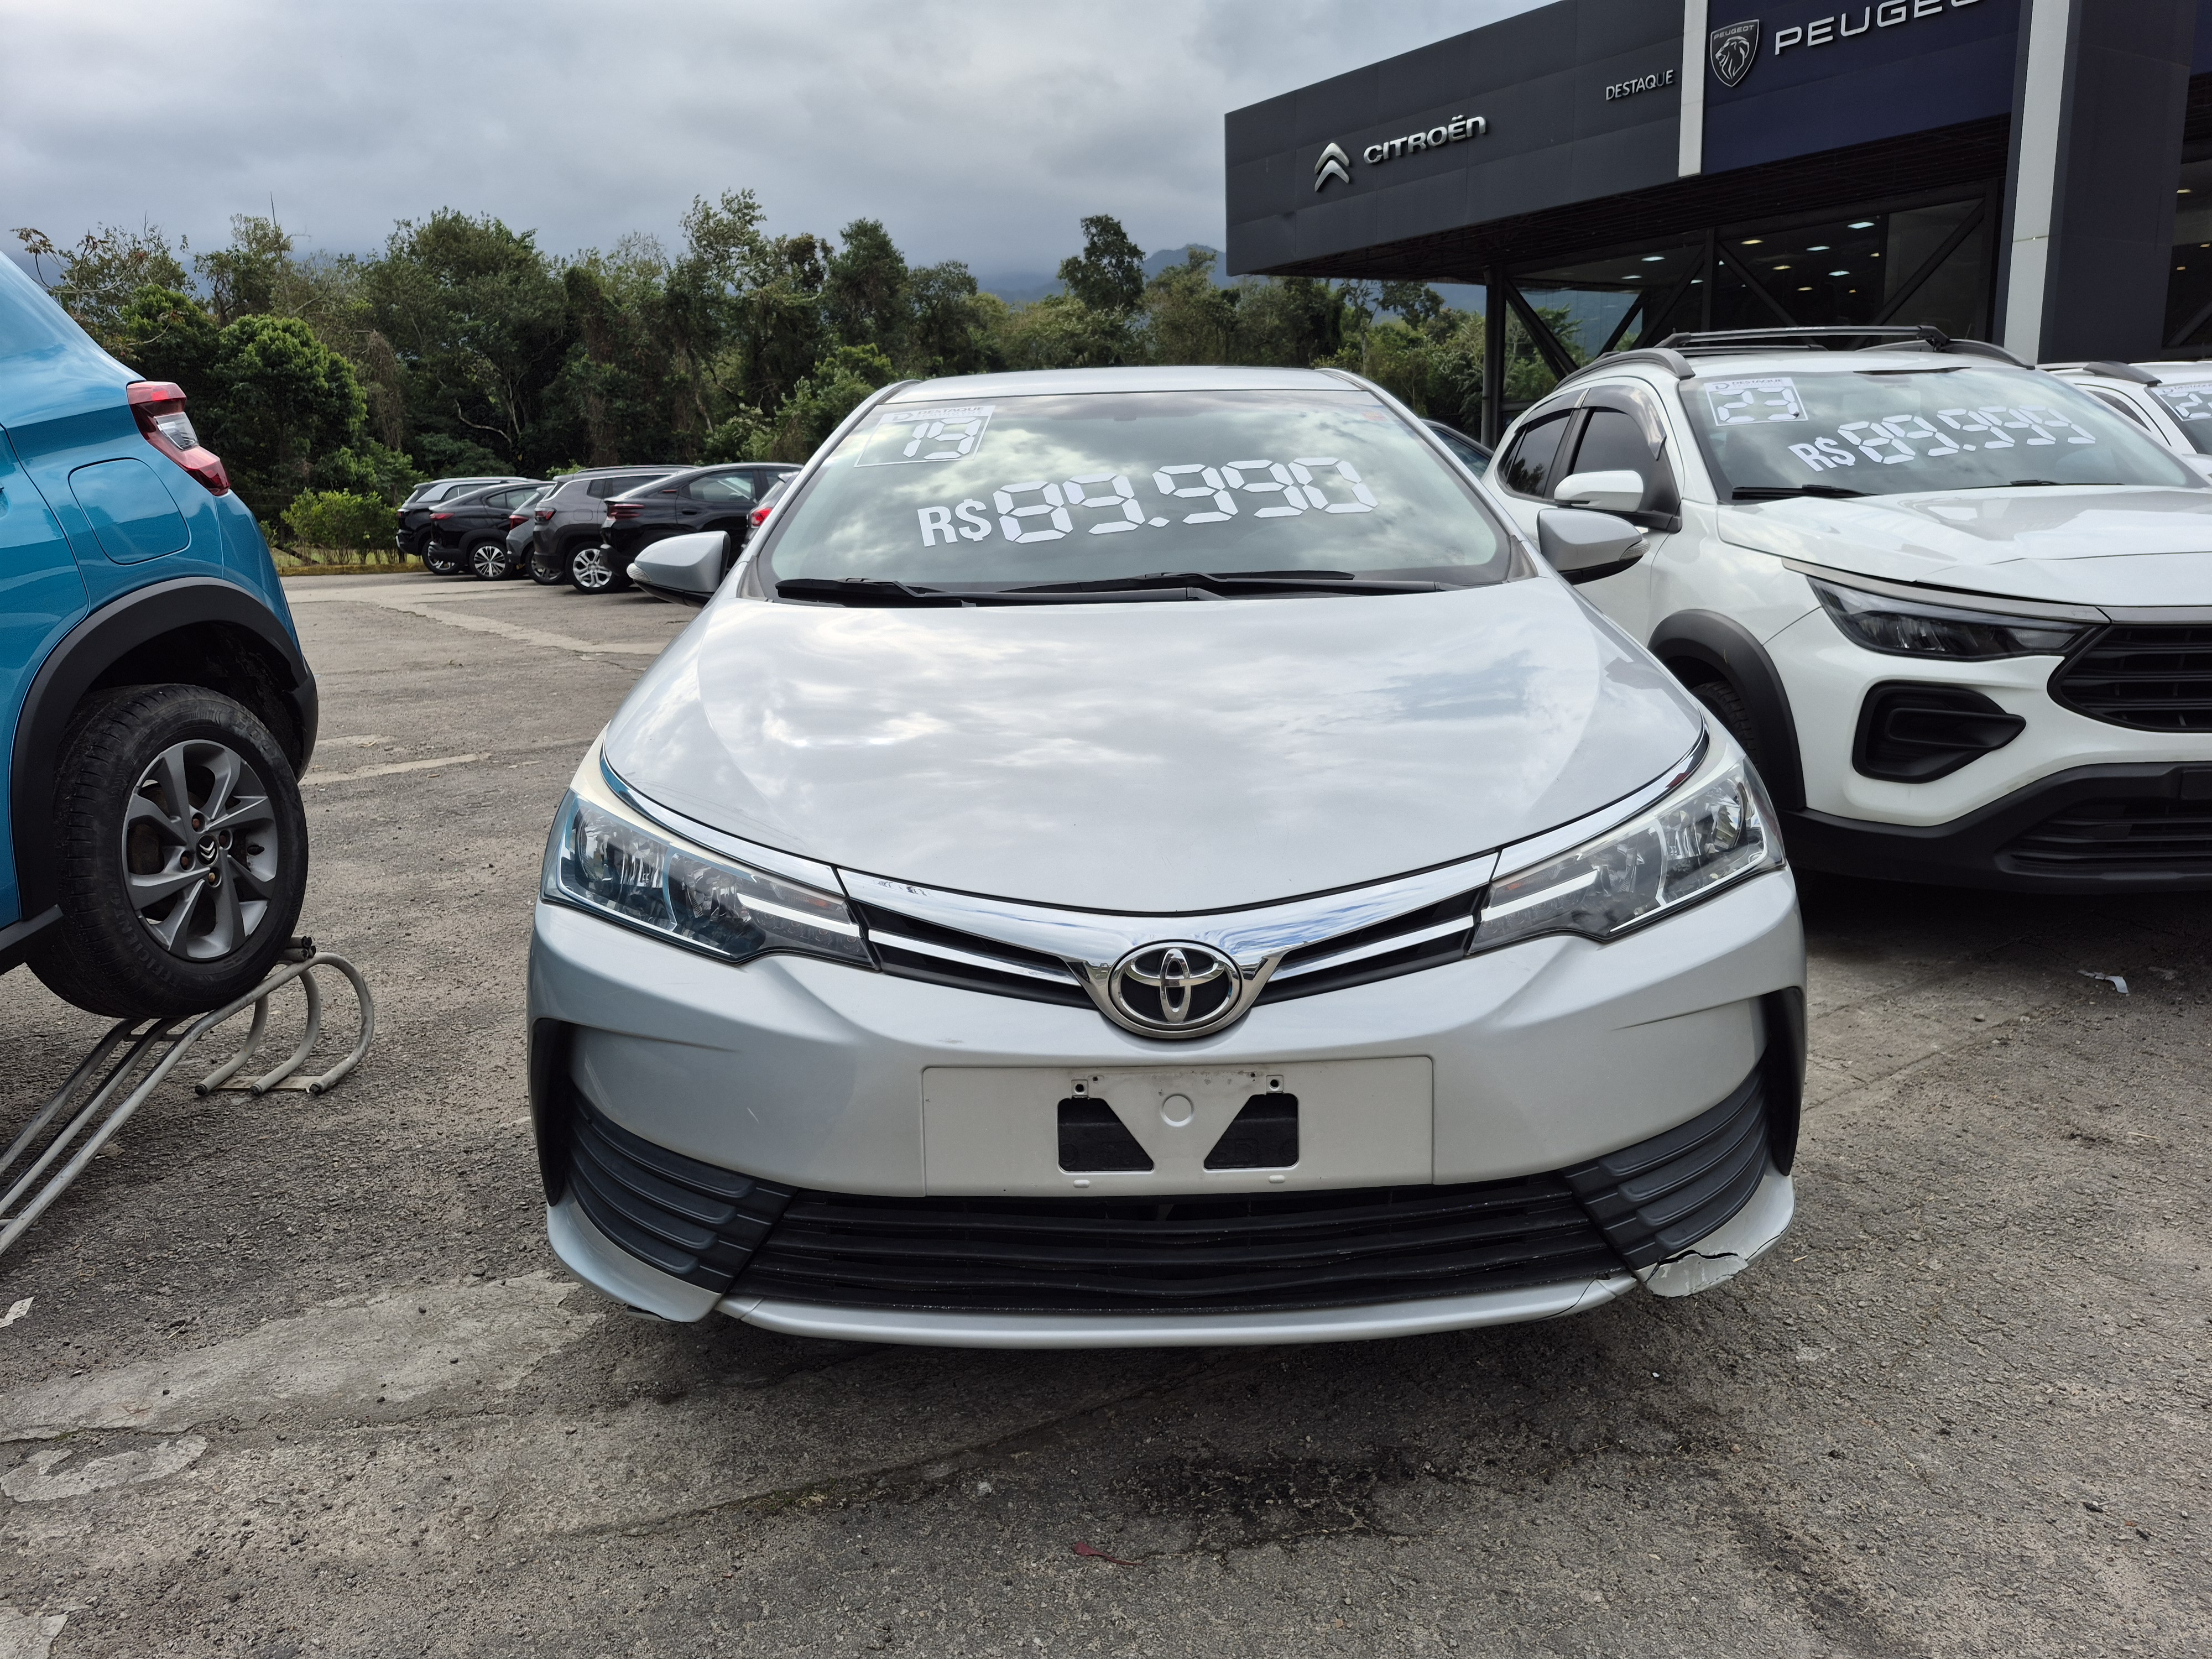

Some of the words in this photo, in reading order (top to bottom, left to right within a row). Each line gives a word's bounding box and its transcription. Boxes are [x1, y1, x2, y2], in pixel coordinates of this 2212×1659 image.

[1714, 24, 1755, 40] PEUGEOT
[1775, 0, 1980, 55] PEUGE
[1606, 69, 1673, 100] DESTAQUE
[918, 406, 984, 415] DESTAQUE
[1717, 387, 1799, 423] 23
[2167, 392, 2212, 419] 2
[903, 417, 982, 460] 19
